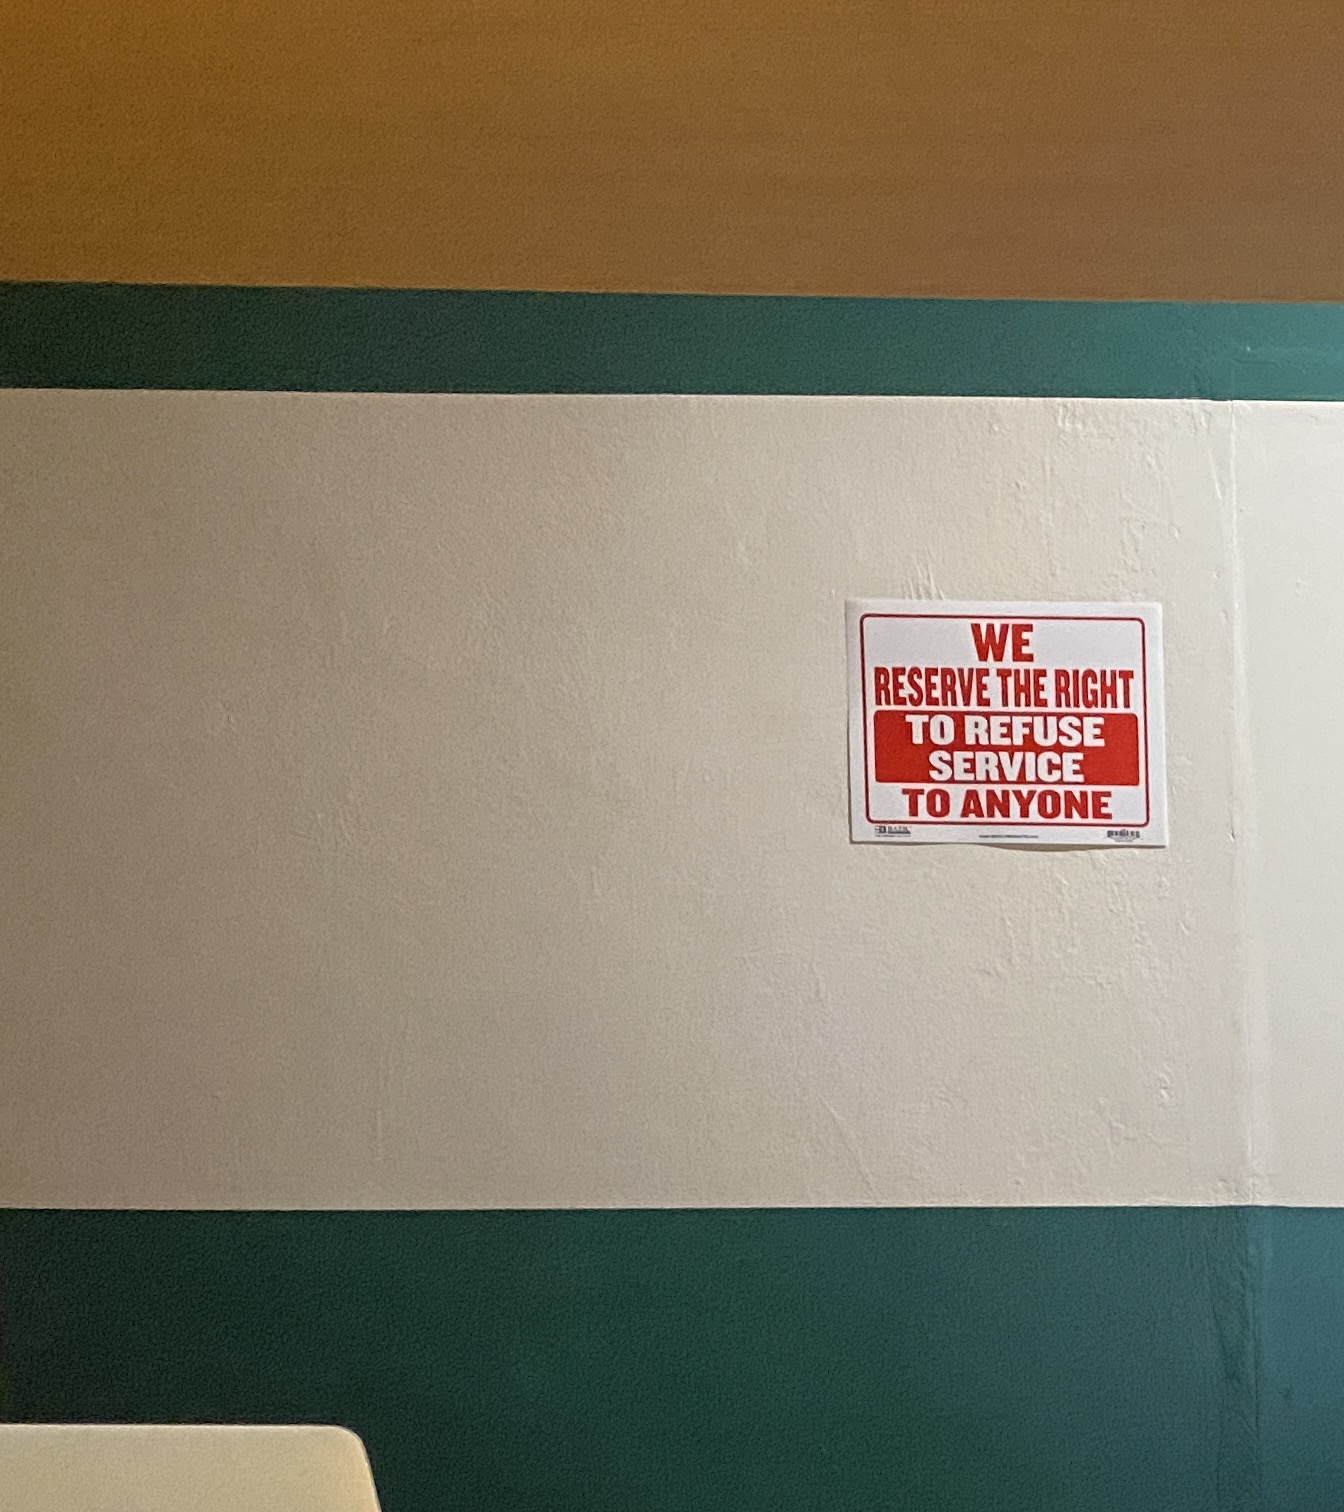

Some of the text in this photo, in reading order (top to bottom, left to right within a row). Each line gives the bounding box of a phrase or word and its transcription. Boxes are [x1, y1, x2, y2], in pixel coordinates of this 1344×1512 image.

[971, 623, 1034, 663] WE
[874, 666, 1135, 709] RESERVE THE RIGHT
[905, 714, 1106, 748] TO REFUSE
[928, 750, 1085, 783] SERVICE
[902, 788, 1113, 820] TO ANYONE
